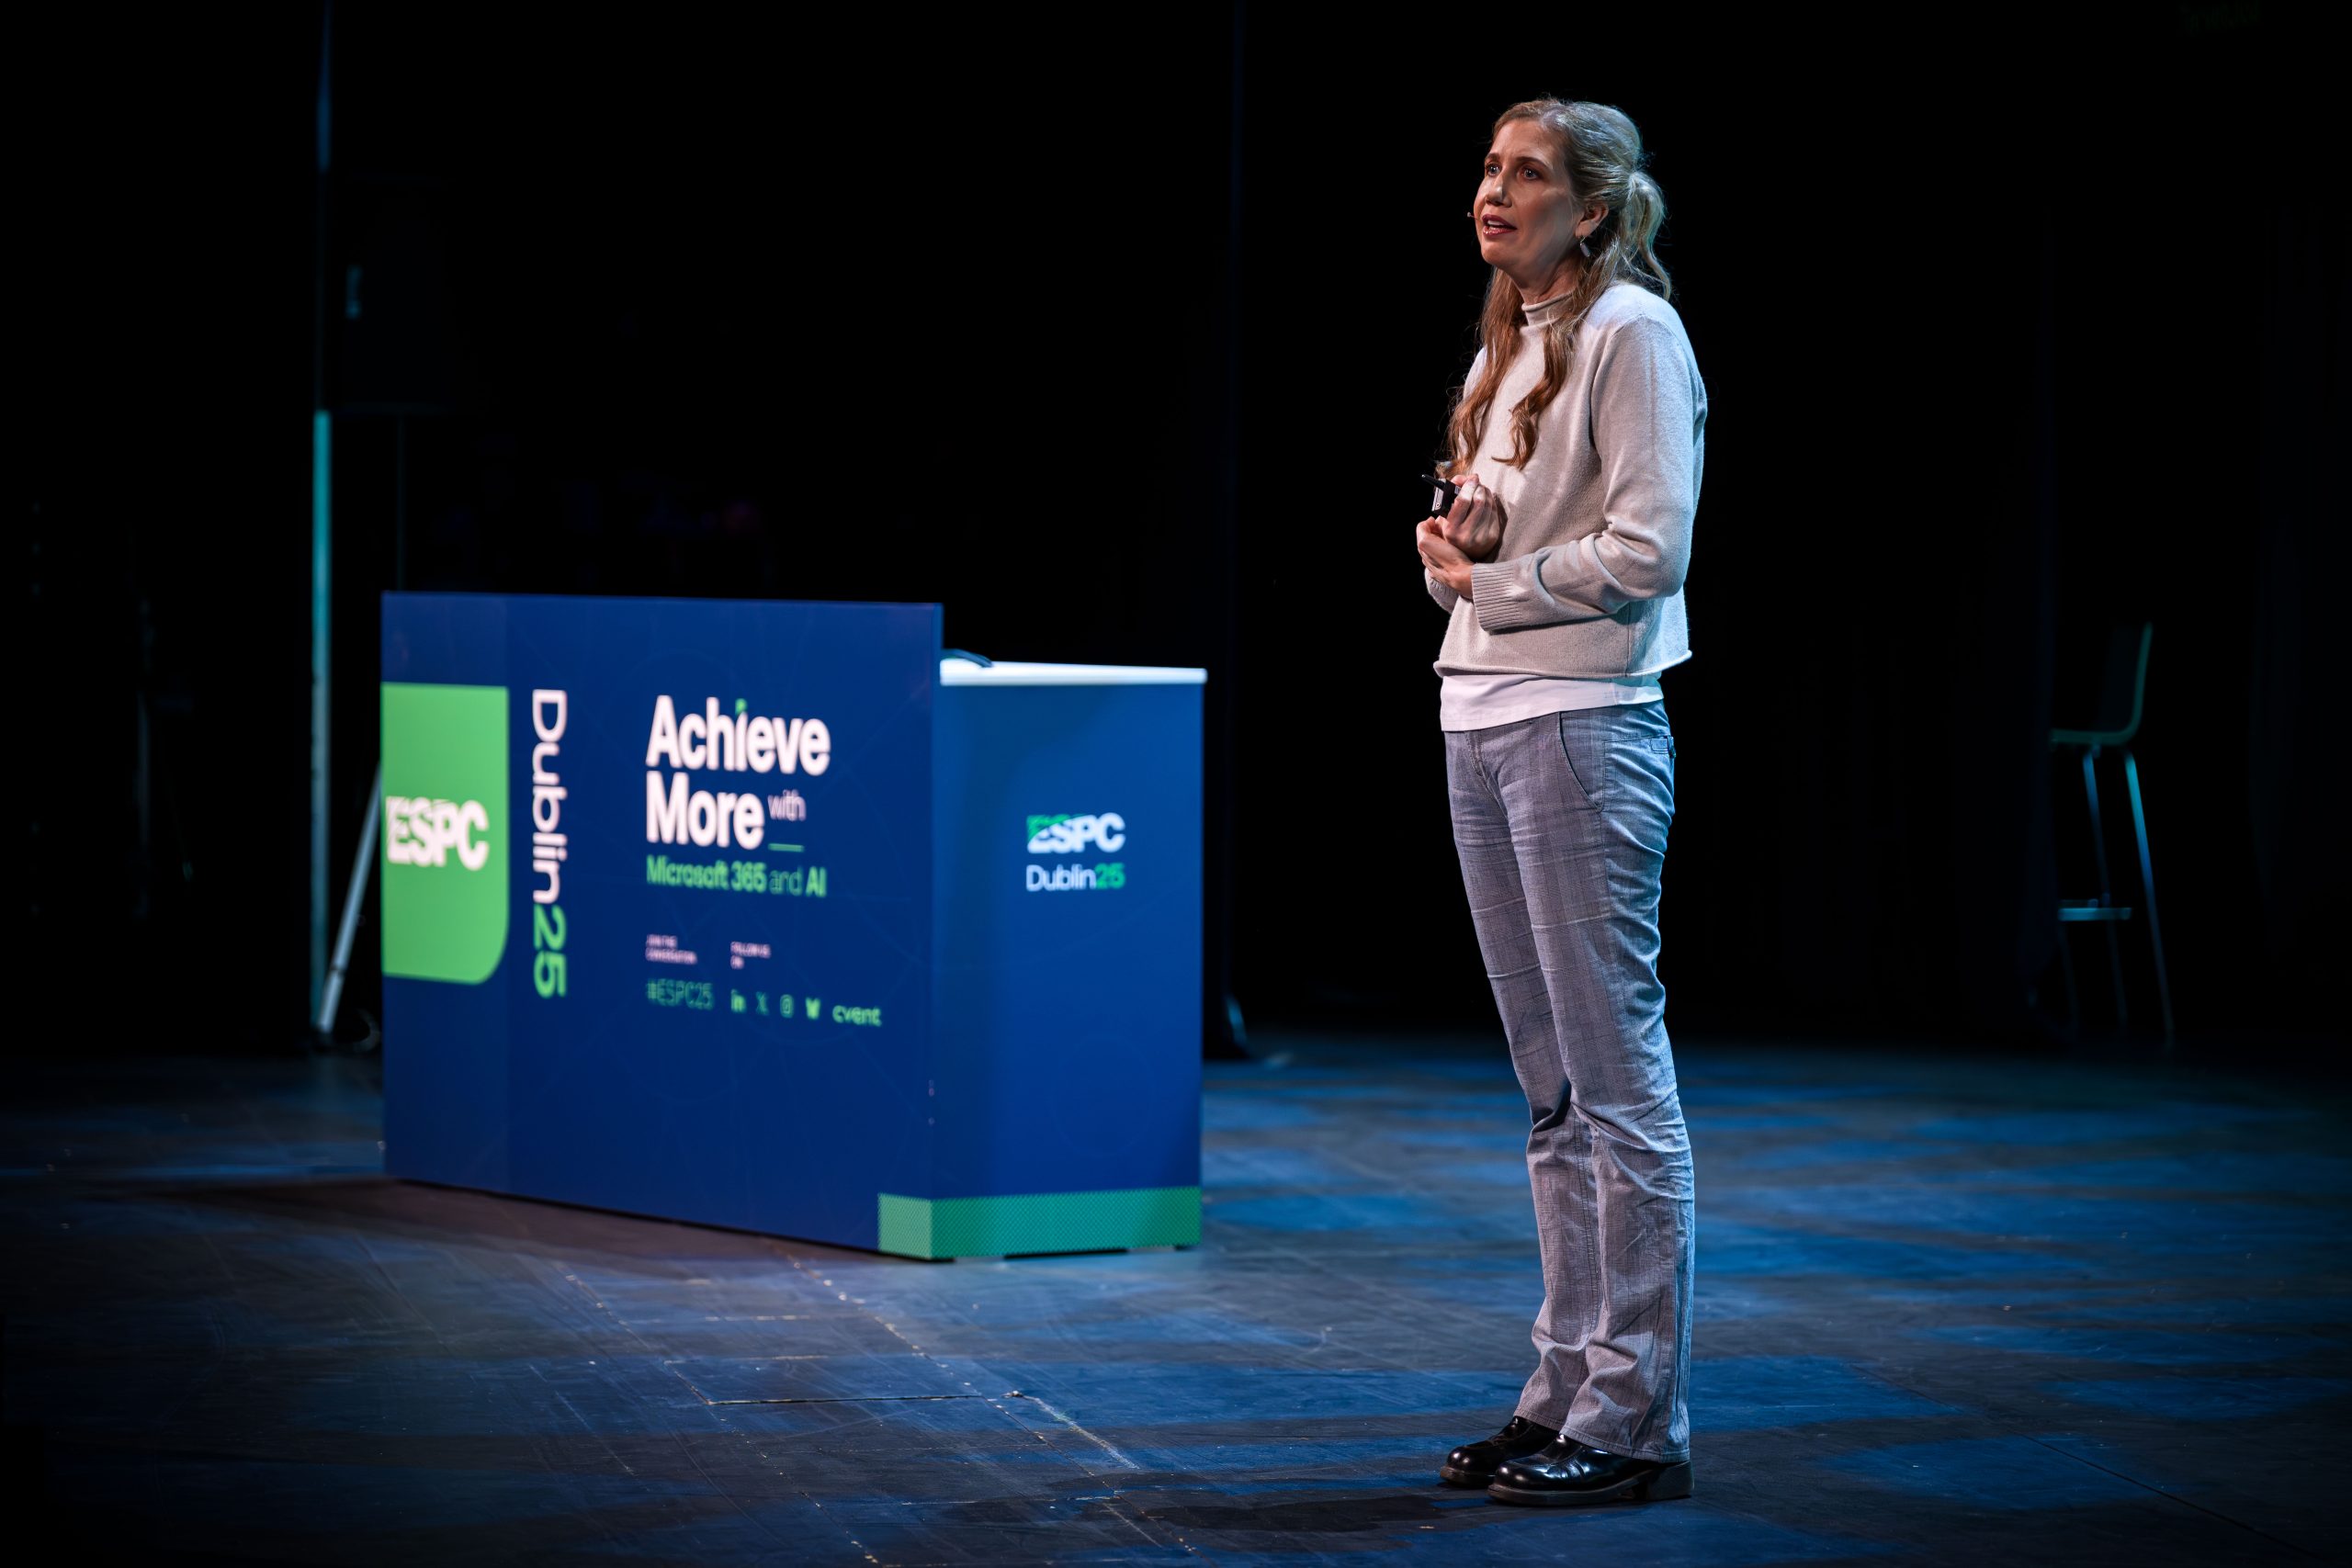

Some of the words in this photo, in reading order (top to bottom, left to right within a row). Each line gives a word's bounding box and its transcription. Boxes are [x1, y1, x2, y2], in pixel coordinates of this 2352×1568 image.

[646, 694, 831, 776] Achieve
[646, 770, 764, 850] More
[767, 789, 807, 821] with
[386, 795, 490, 871] ESPC
[532, 689, 568, 998] Dublin25
[1026, 812, 1125, 853] ESPC
[646, 854, 729, 890] Microsoft
[730, 860, 767, 894] 365
[769, 866, 803, 897] and
[805, 866, 827, 897] AI
[1025, 862, 1125, 892] Dublin25
[645, 978, 714, 1010] #ESPC25
[831, 1005, 882, 1027] cvent
